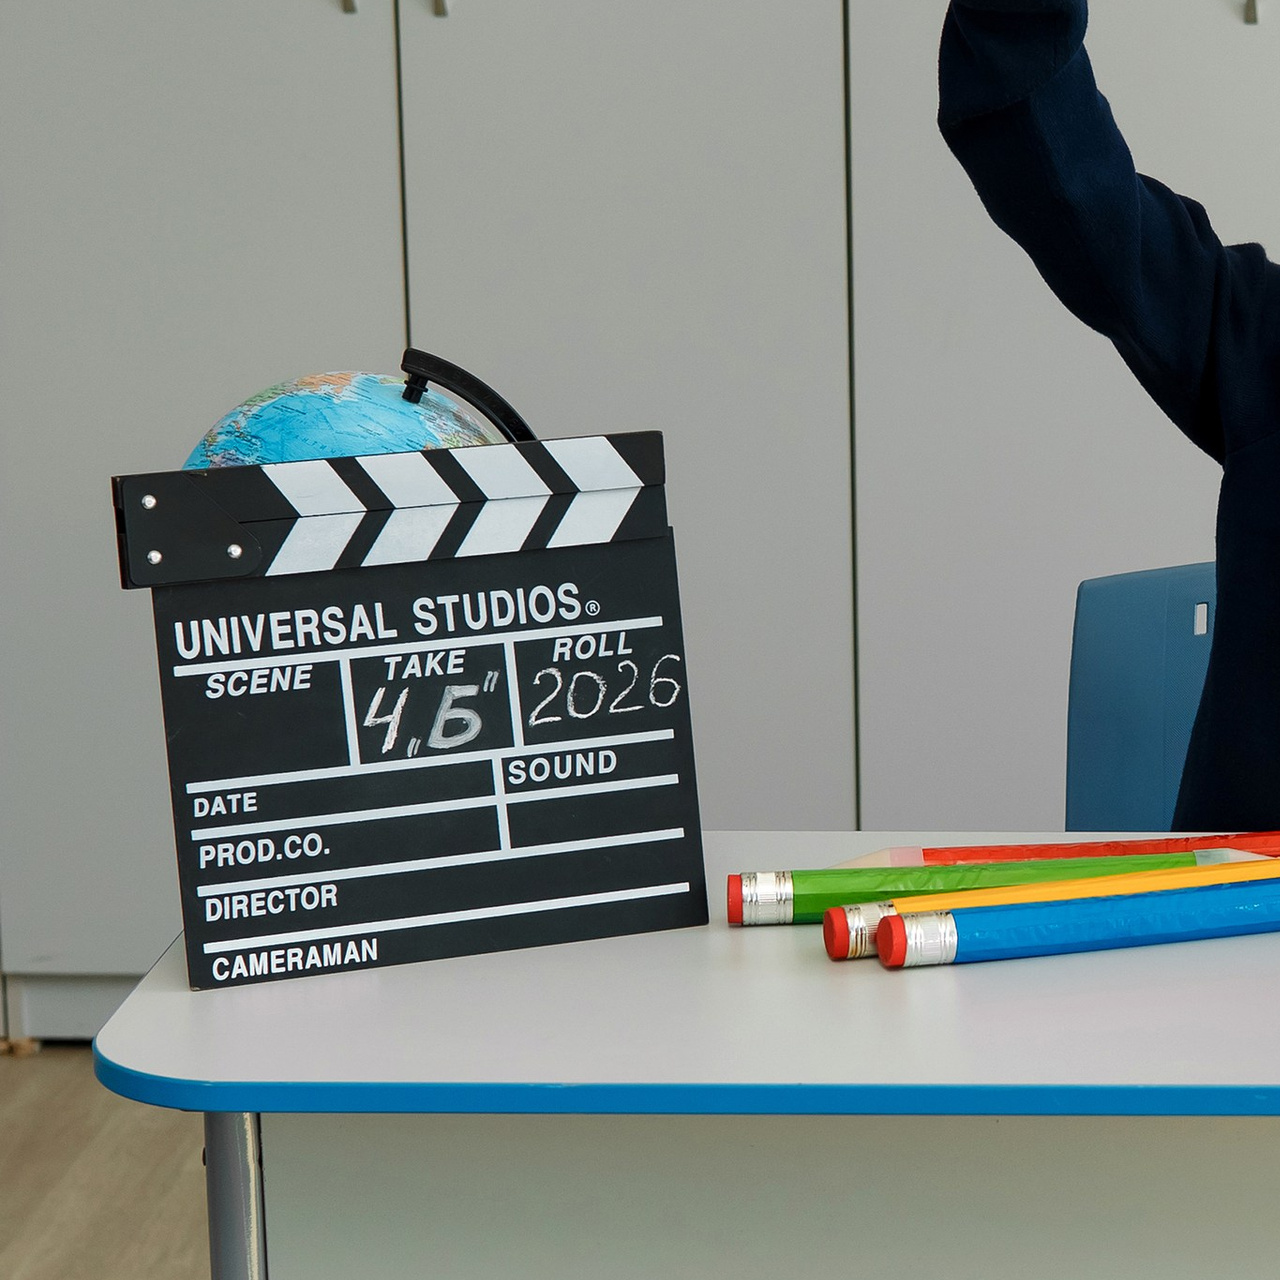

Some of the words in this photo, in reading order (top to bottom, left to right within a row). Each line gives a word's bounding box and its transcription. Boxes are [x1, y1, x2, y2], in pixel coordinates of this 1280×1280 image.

[174, 602, 398, 660] UNIVERSAL
[552, 631, 633, 663] ROLL
[205, 664, 313, 699] SCENE
[384, 649, 467, 680] TAKE
[529, 654, 681, 727] 2026
[508, 749, 618, 786] SOUND
[193, 792, 258, 818] DATE
[199, 832, 331, 869] PROD.CO.
[205, 883, 338, 922] DIRECTOR
[212, 937, 379, 981] CAMERAMAN
